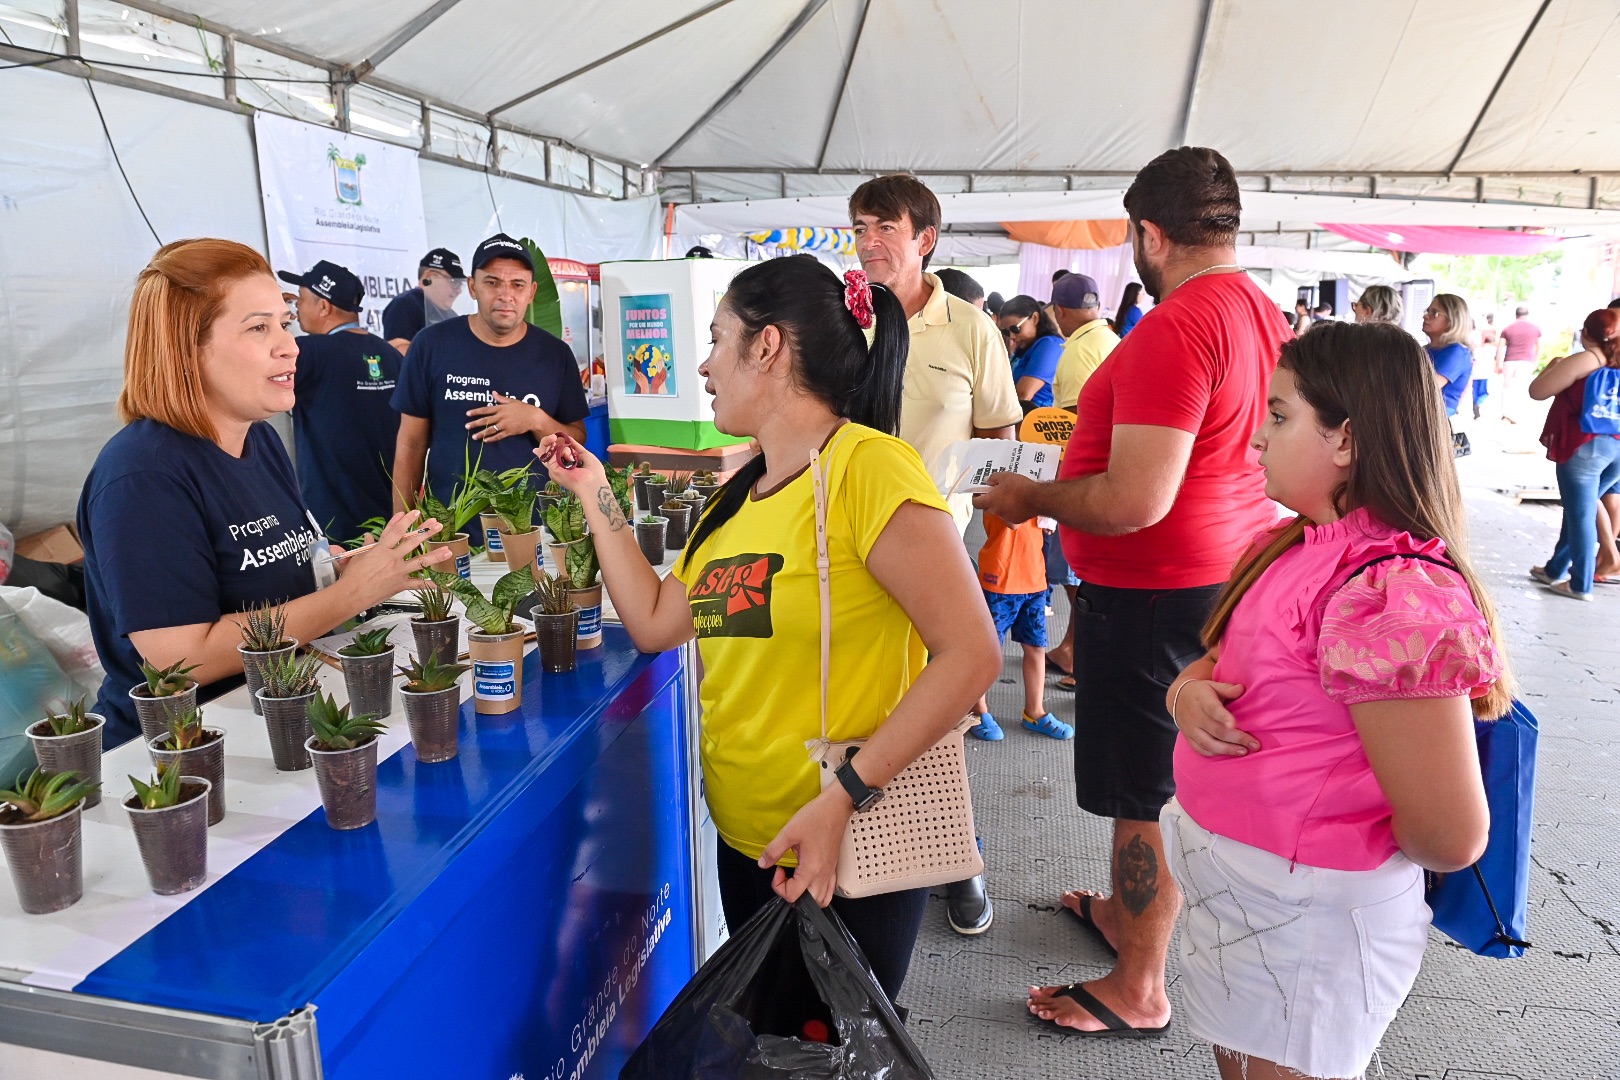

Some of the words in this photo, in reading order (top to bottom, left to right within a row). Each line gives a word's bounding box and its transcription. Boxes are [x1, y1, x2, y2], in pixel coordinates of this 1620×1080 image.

[626, 308, 667, 321] JUNTOS
[626, 328, 668, 339] MELHOR
[446, 374, 490, 386] Programa
[1033, 420, 1075, 433] EGURO
[229, 514, 280, 541] Programa
[240, 525, 314, 571] Assembleia
[693, 609, 723, 635] nfecções
[618, 906, 671, 1003] Legislativa
[543, 1057, 565, 1080] io
[571, 966, 618, 1053] Grande
[623, 935, 637, 966] do
[641, 882, 670, 936] Norte
